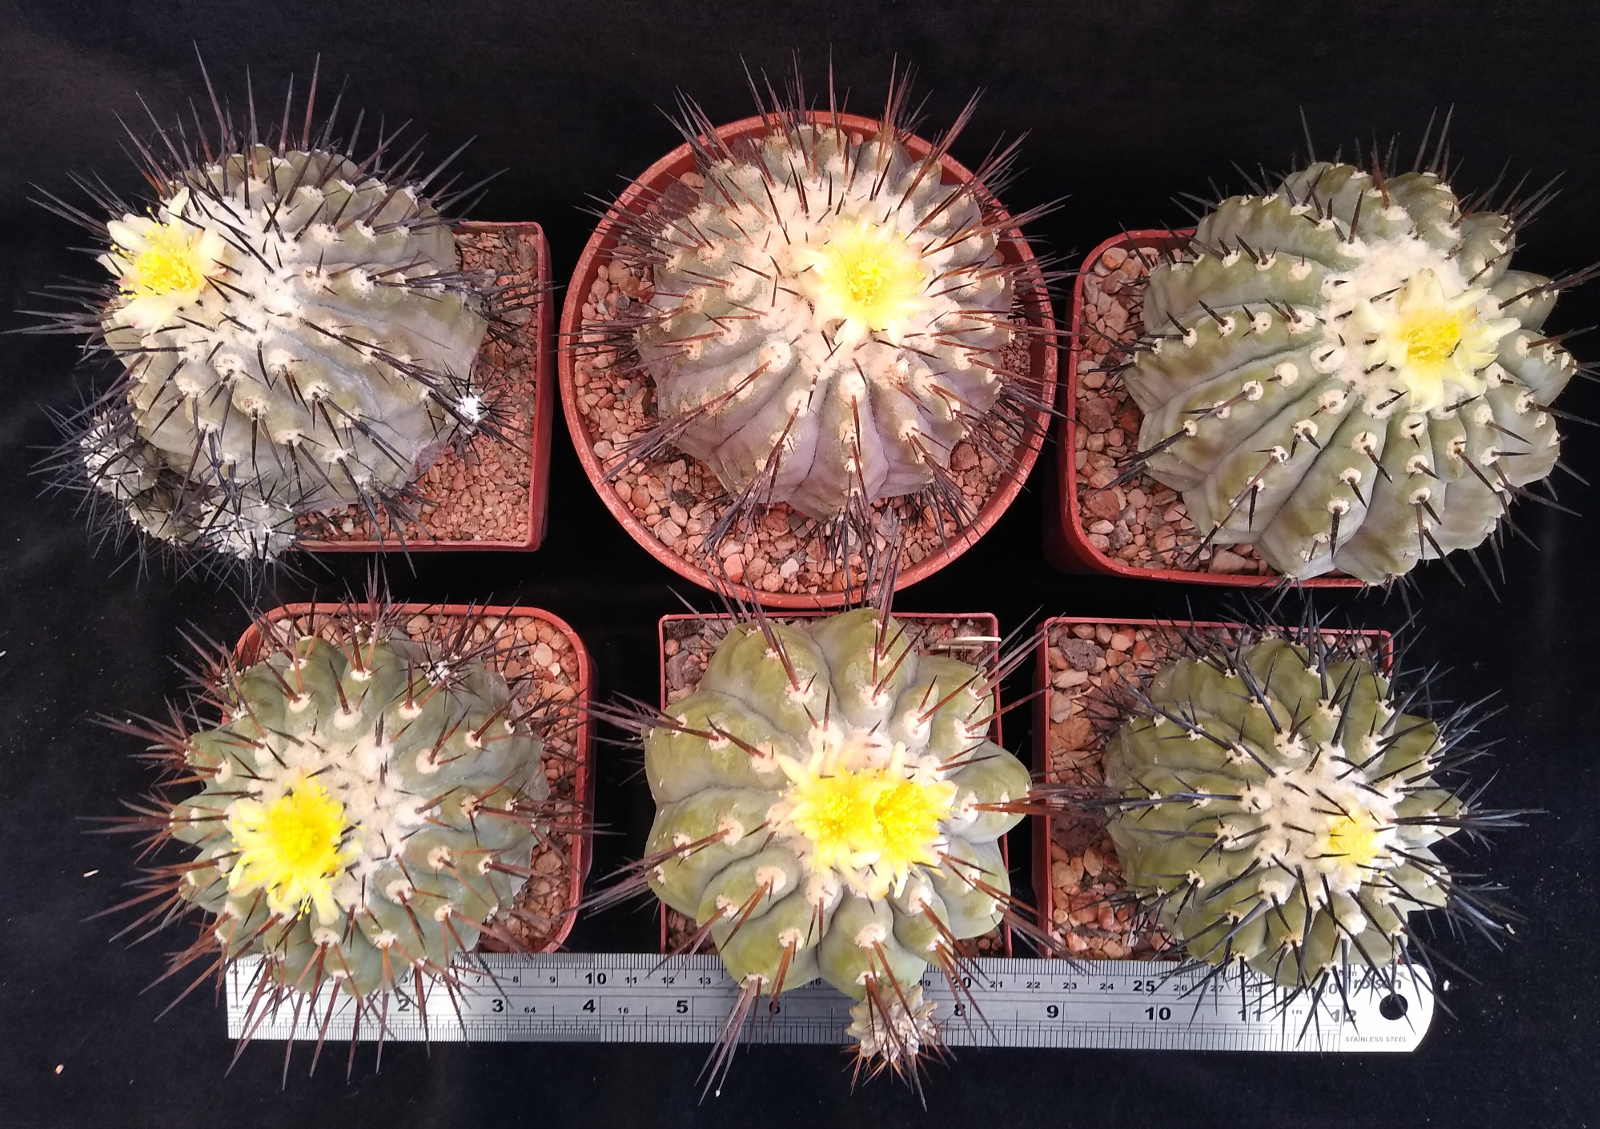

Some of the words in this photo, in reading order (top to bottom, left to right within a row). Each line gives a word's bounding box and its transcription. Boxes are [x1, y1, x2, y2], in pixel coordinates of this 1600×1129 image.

[549, 976, 556, 984] 9
[585, 972, 607, 985] 10
[625, 976, 637, 984] 11
[661, 976, 675, 984] 12
[698, 977, 711, 985] 13
[951, 976, 972, 989] 20
[1026, 981, 1041, 989] 22
[1063, 982, 1077, 990] 23
[1133, 980, 1155, 992] 25
[1173, 984, 1187, 992] 26
[397, 999, 410, 1012] 2
[492, 999, 504, 1013] 3
[524, 1006, 536, 1014] 64
[582, 999, 596, 1013] 4
[676, 1000, 689, 1014] 5
[769, 1000, 781, 1014] 6
[953, 1004, 966, 1017] 8
[1046, 1005, 1059, 1018] 9
[1145, 1007, 1171, 1020] 10
[1331, 1009, 1357, 1022] 12
